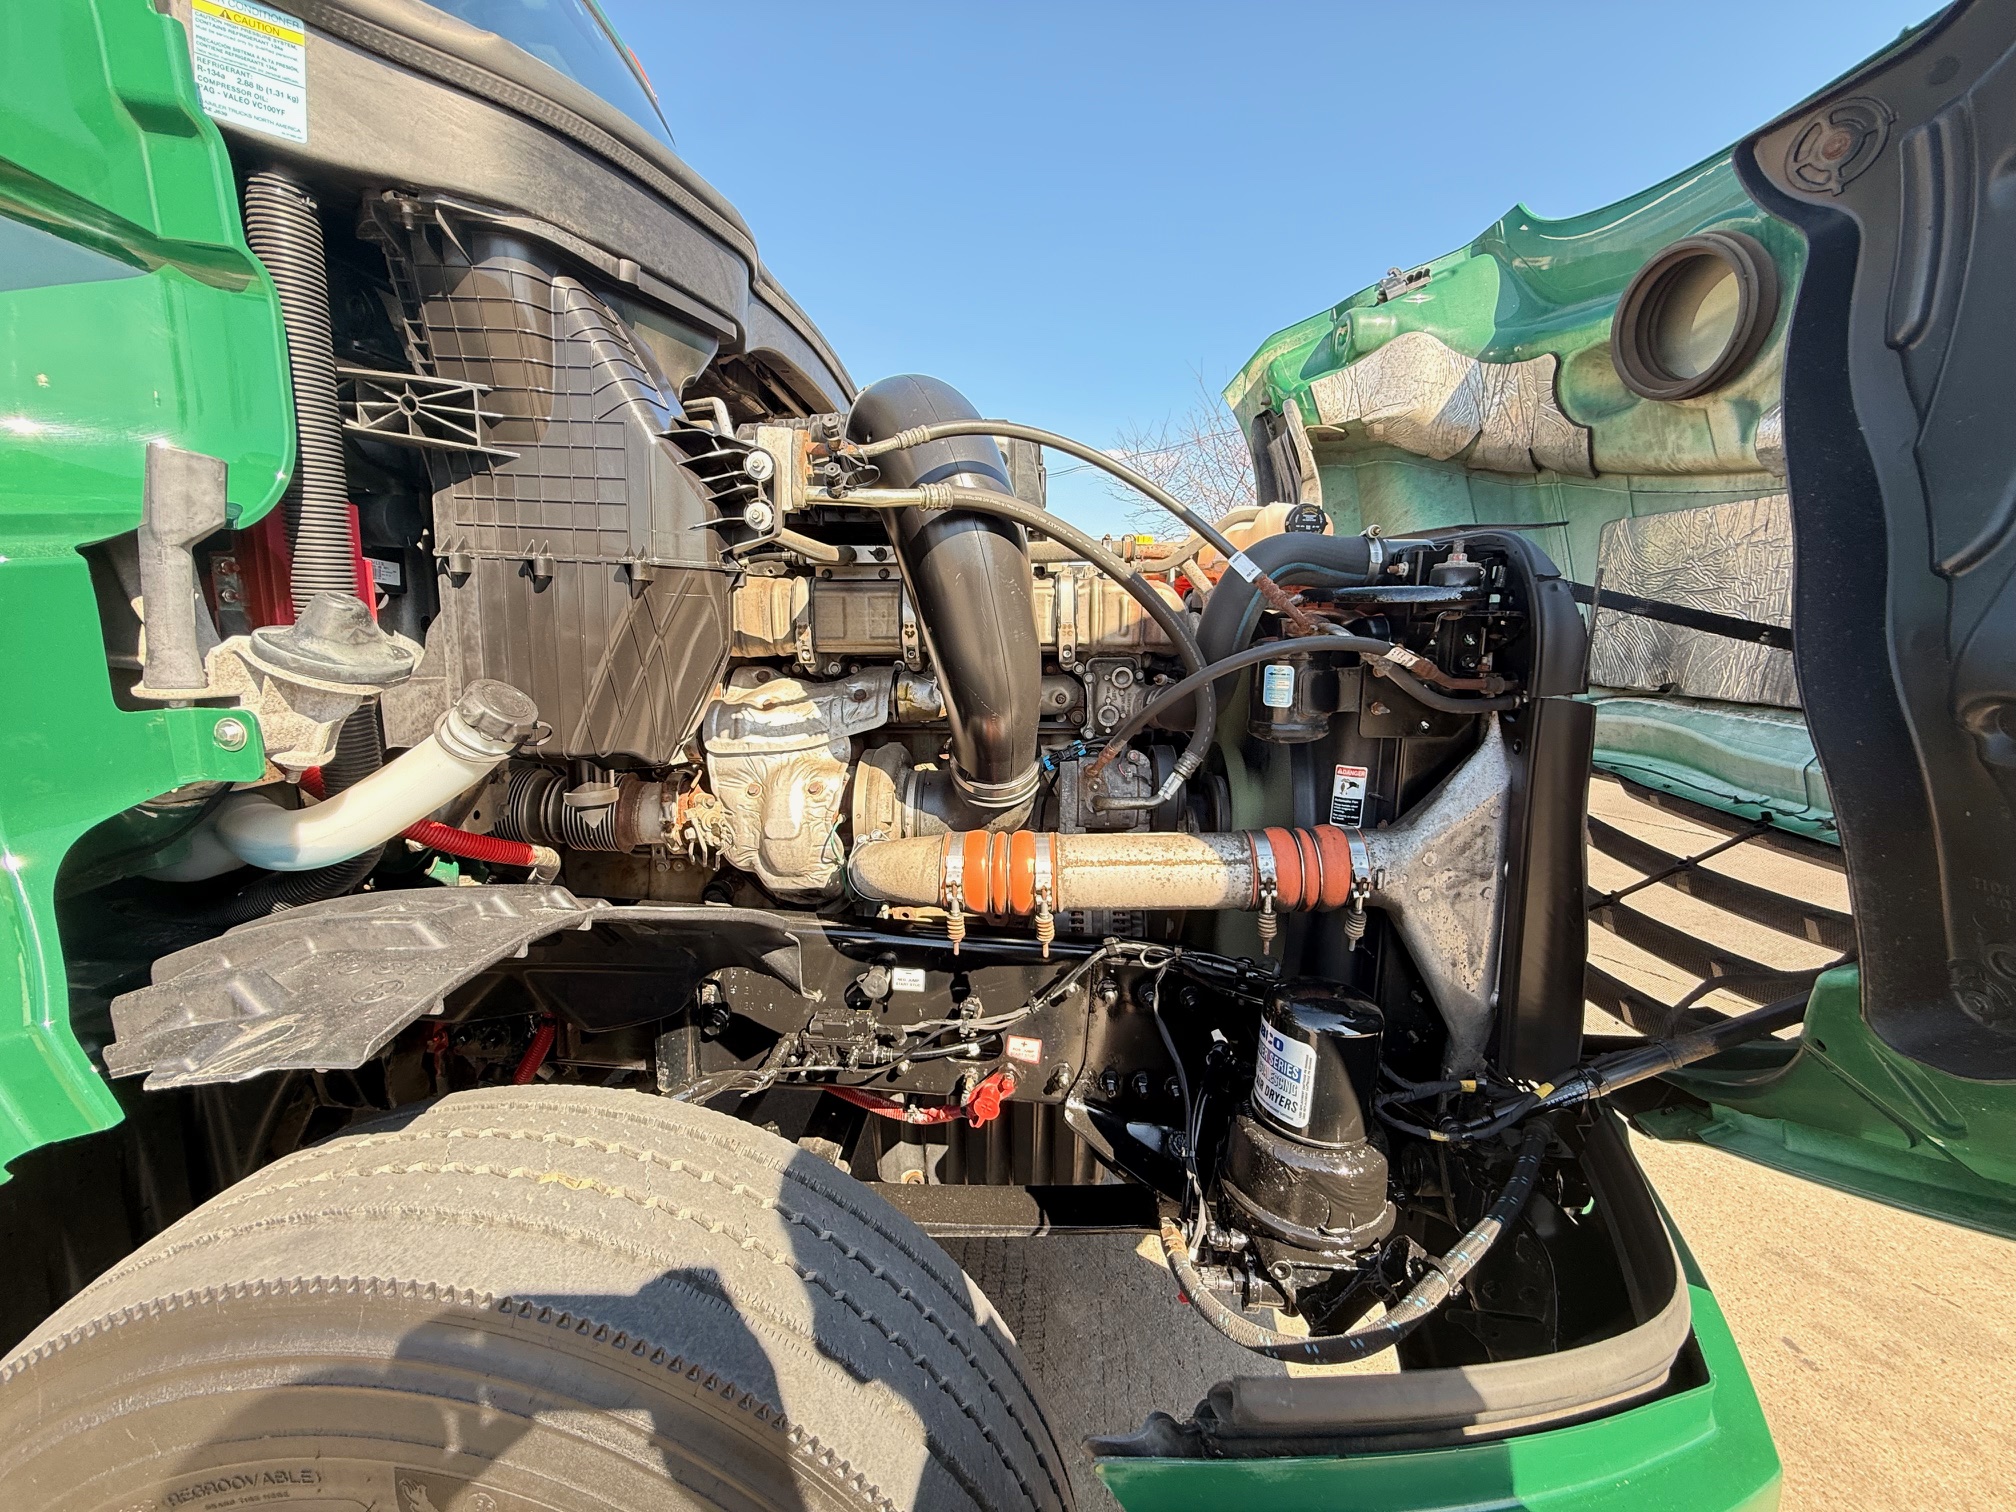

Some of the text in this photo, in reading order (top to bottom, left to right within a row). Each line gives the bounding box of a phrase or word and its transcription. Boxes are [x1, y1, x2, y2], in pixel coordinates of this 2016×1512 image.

[233, 14, 280, 36] CAUTION
[197, 56, 253, 79] REFRIGERANT:
[197, 64, 226, 80] R-134a
[236, 77, 254, 89] 2.88
[256, 83, 264, 92] lb
[287, 93, 300, 104] kg)
[197, 74, 252, 98] COMPRESSOR
[223, 91, 250, 105] VALEO
[252, 99, 286, 116] VC100YF
[1269, 1053, 1300, 1080] SERIES
[1264, 1085, 1299, 1113] DRYERS
